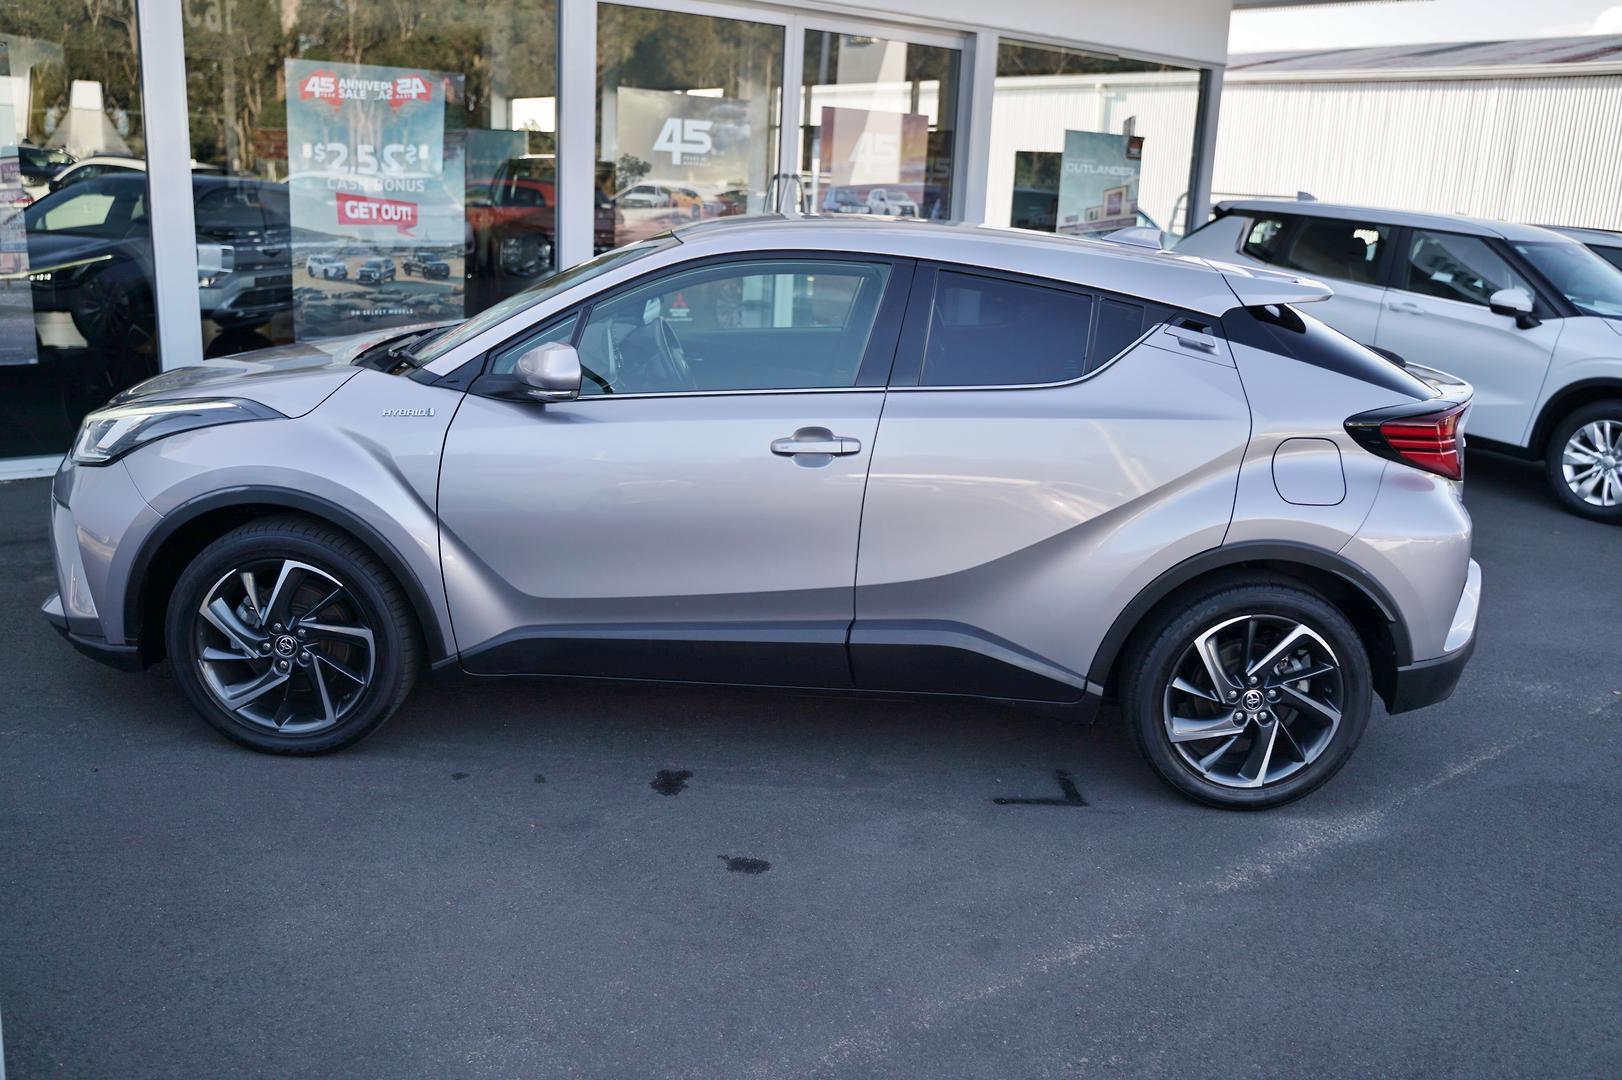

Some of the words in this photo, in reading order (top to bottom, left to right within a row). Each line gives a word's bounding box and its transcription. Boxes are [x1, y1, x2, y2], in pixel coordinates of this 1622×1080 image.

[305, 76, 335, 98] 45
[338, 89, 367, 100] SALE
[653, 117, 714, 165] 45
[848, 132, 898, 174] 45
[1066, 163, 1135, 176] OUTLANDER
[345, 200, 379, 219] GET
[381, 204, 412, 221] OUT!
[382, 408, 426, 417] HYBRID
